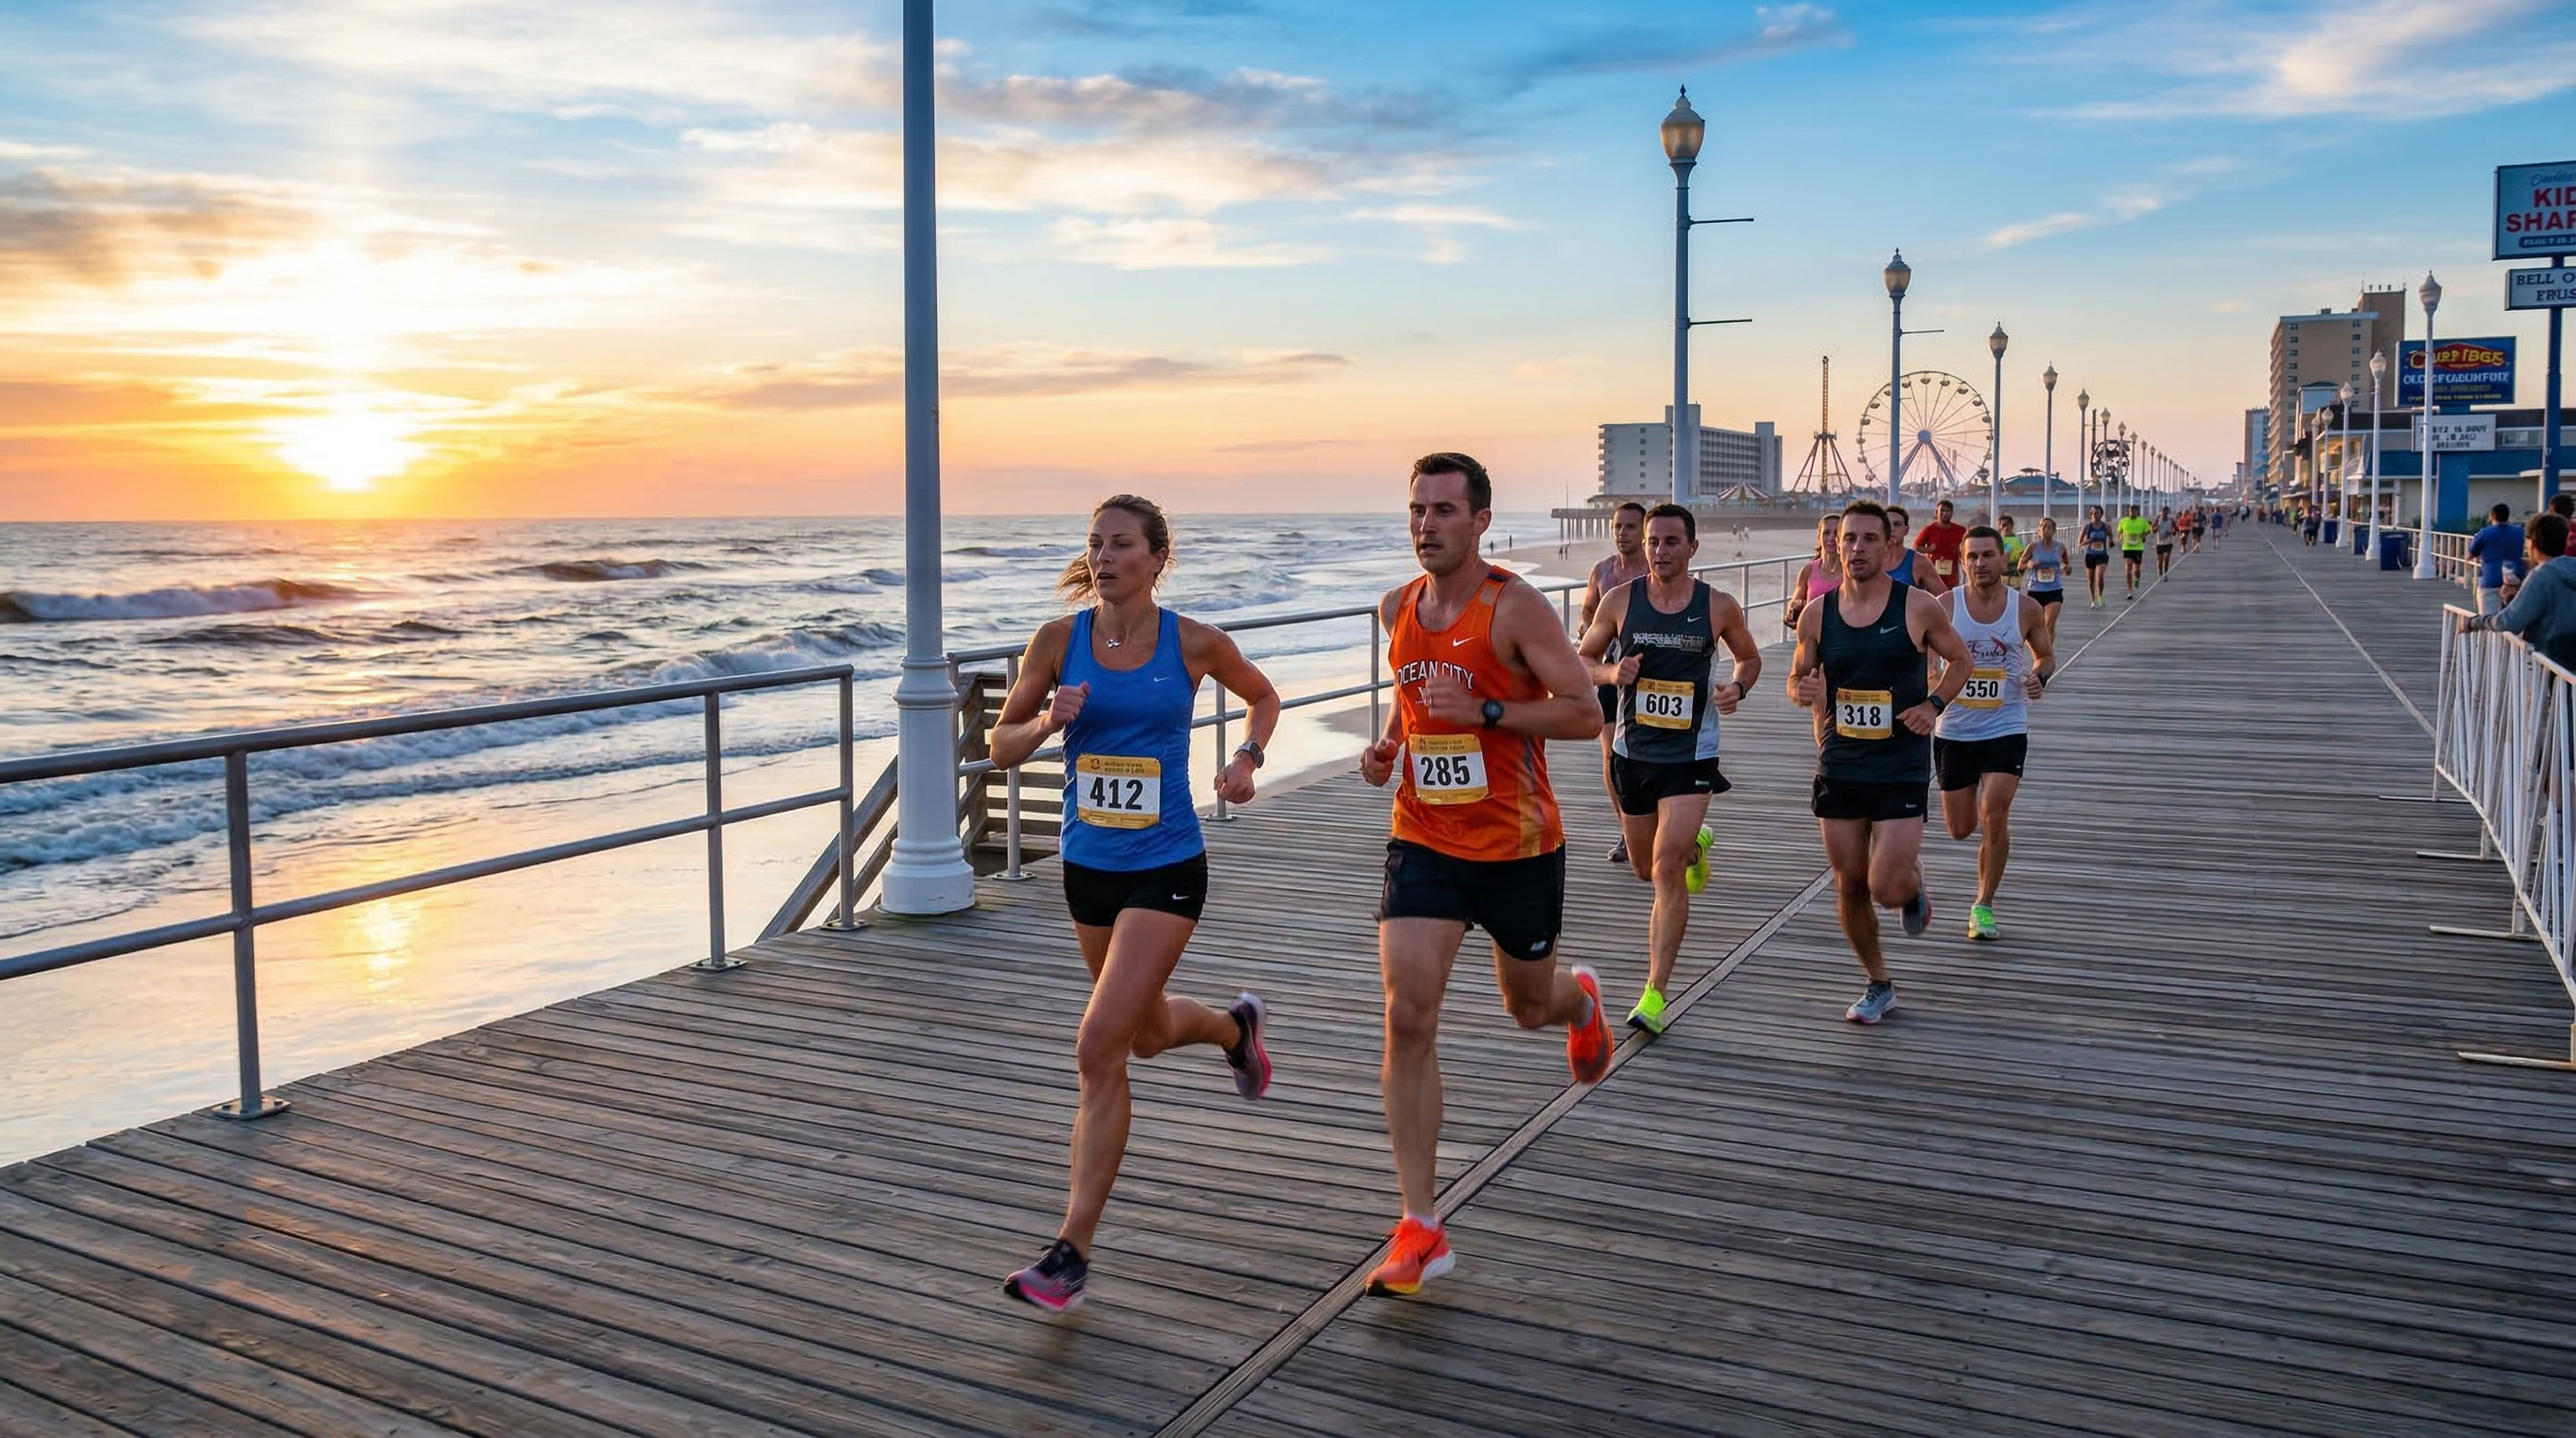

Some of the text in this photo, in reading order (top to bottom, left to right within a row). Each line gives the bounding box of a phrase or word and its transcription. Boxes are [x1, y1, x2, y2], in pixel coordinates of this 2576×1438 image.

[2516, 273, 2555, 286] BELL
[1398, 661, 1474, 690] OCEAN CITY
[1966, 681, 1998, 698] 550
[1646, 694, 1683, 717] 603
[1844, 704, 1881, 726] 318
[1420, 756, 1471, 786] 285
[1090, 776, 1144, 811] 412
